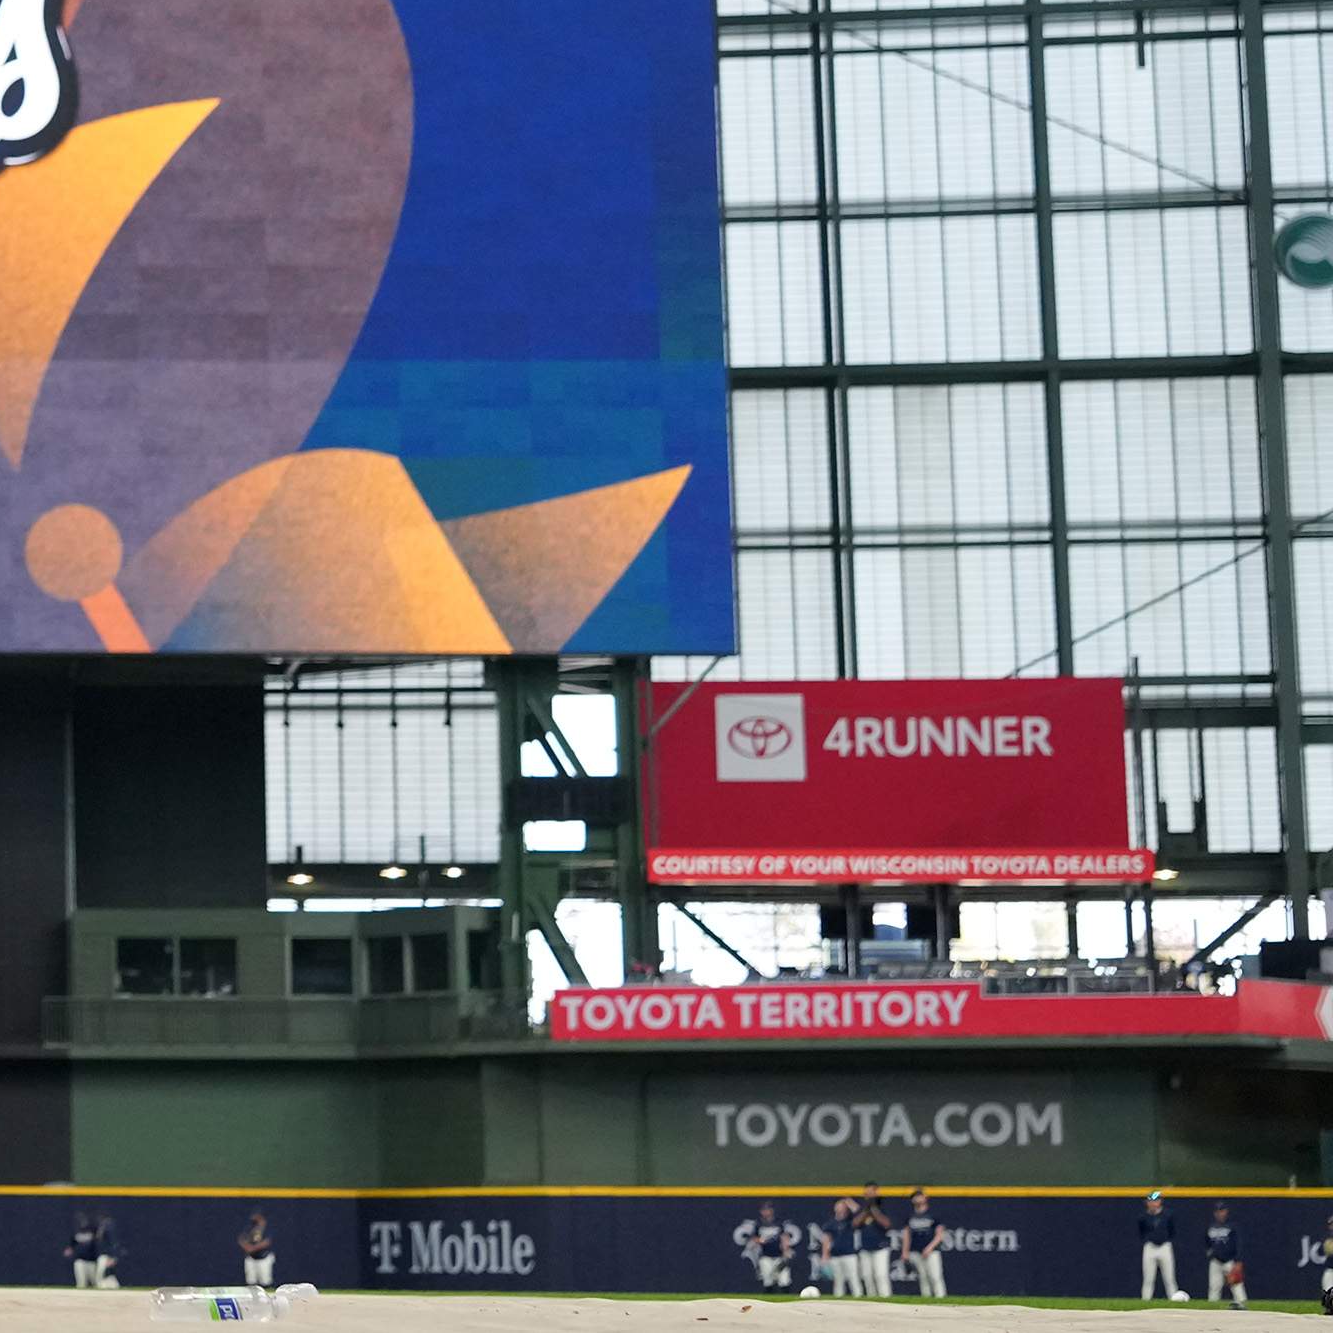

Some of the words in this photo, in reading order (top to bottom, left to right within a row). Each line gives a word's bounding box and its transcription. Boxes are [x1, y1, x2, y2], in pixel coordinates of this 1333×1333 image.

[824, 715, 1054, 758] 4RUNNER
[652, 854, 755, 876] COURTESY
[759, 855, 787, 876] OF
[790, 855, 846, 876] YOUR
[850, 855, 966, 876] WISCONSIN
[970, 855, 1051, 876] TOYOTA
[1054, 855, 1145, 876] DEALERS
[561, 991, 724, 1031] TOYOTA
[734, 988, 970, 1028] TERRITORY
[707, 1103, 1064, 1147] TOYOTA.COM
[407, 1220, 536, 1276] Mobile
